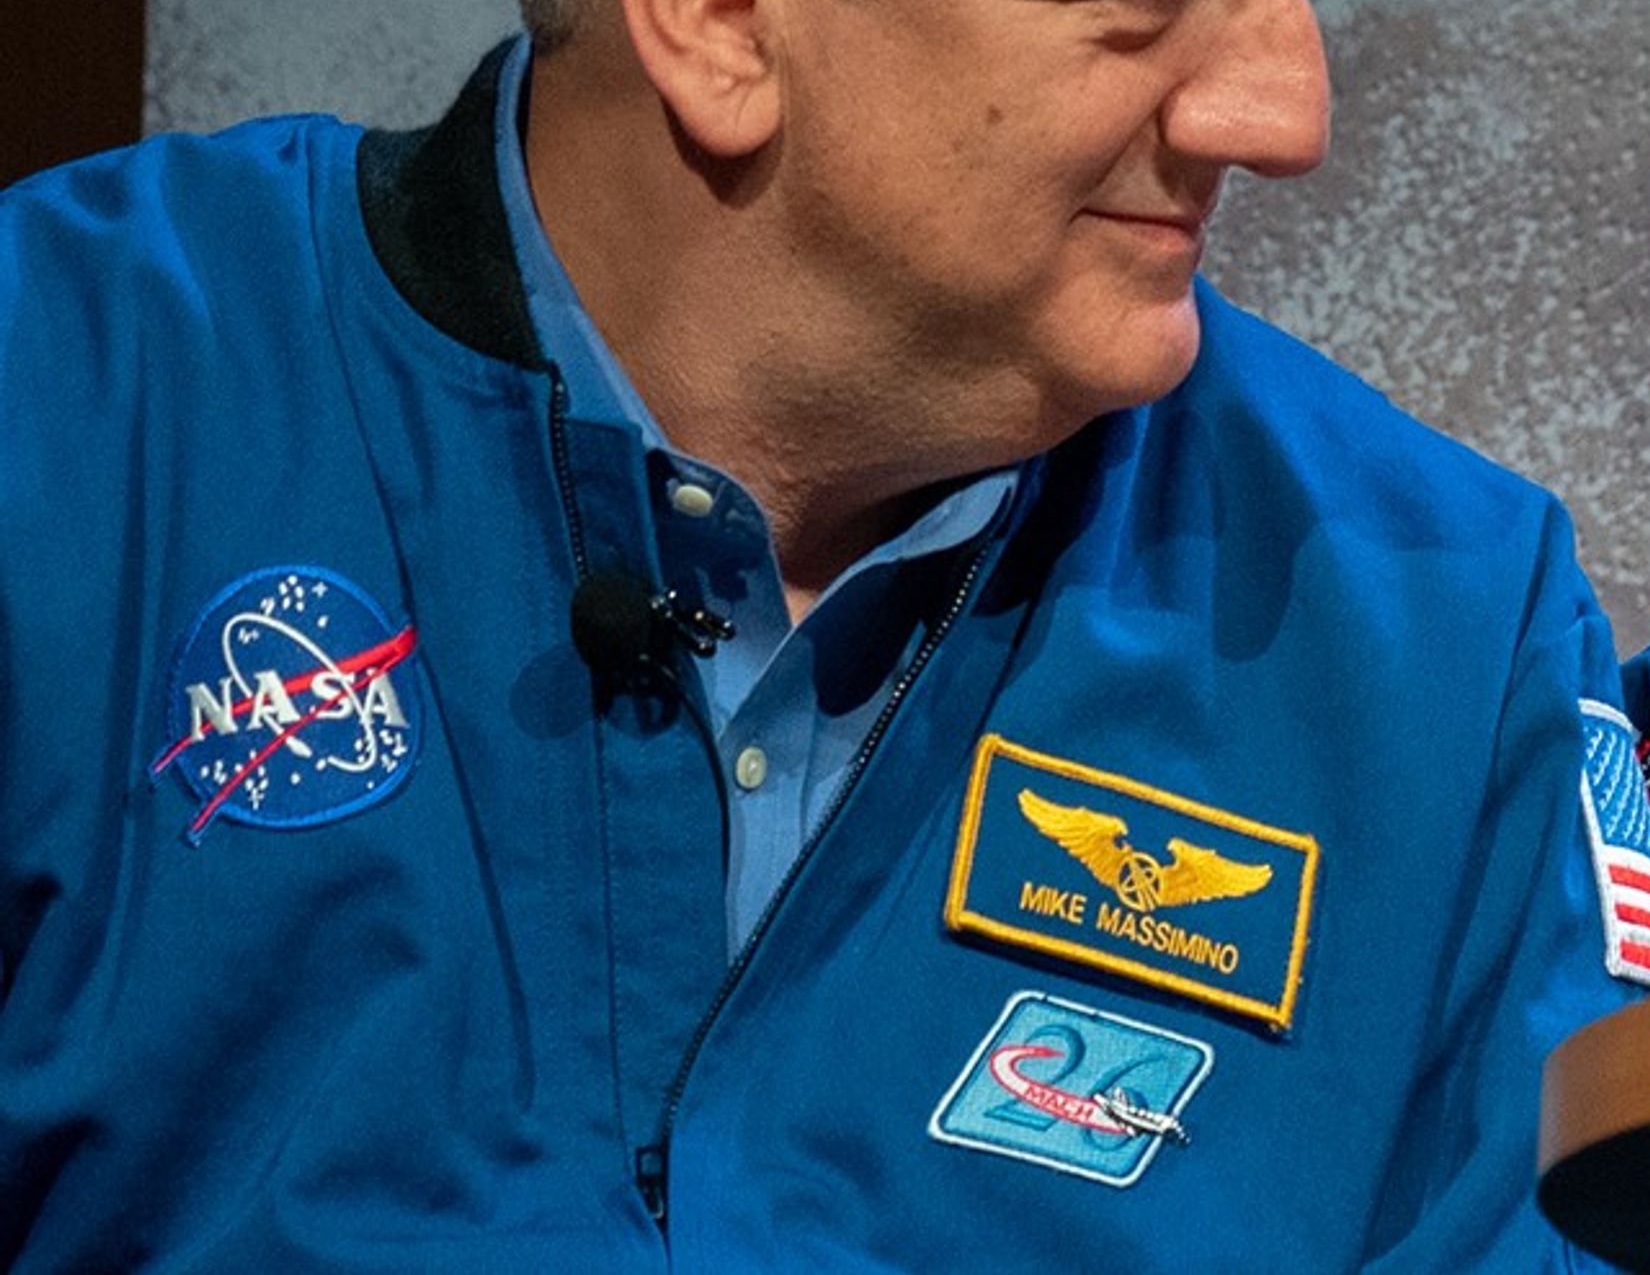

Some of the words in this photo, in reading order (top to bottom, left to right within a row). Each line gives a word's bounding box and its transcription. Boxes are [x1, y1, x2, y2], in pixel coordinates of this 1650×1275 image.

[186, 668, 410, 742] NASA
[1018, 881, 1088, 924] MIKE
[1095, 902, 1239, 975] MASSIMINO
[1023, 1084, 1094, 1122] MACH
